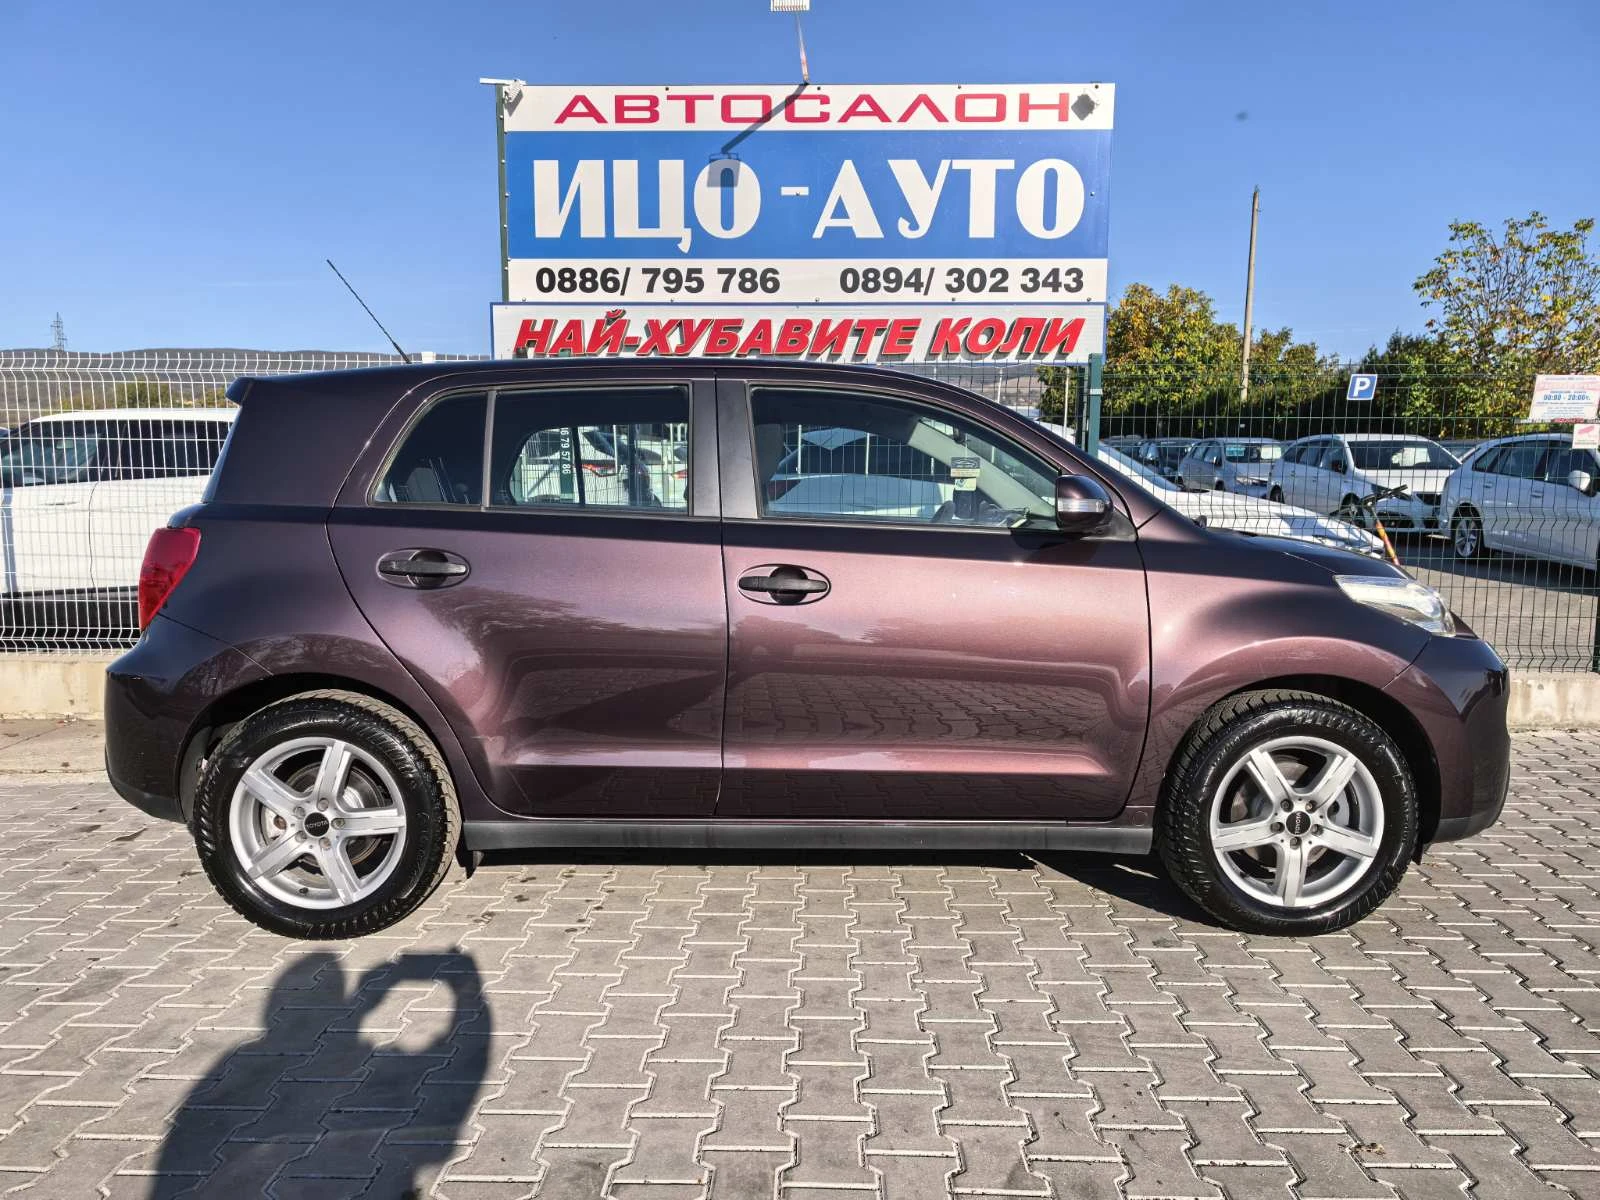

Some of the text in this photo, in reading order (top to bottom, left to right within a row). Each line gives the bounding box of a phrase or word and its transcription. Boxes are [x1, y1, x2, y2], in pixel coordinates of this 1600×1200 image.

[554, 93, 1070, 124] АВТОСАЛОН
[535, 267, 781, 297] 0886/ 795 786
[839, 267, 1084, 297] 0894/ 302 343
[513, 309, 1087, 360] НАЙ-ХУБАВИТЕ КОЛИ
[1353, 377, 1371, 397] P
[305, 820, 328, 829] TOYOTA
